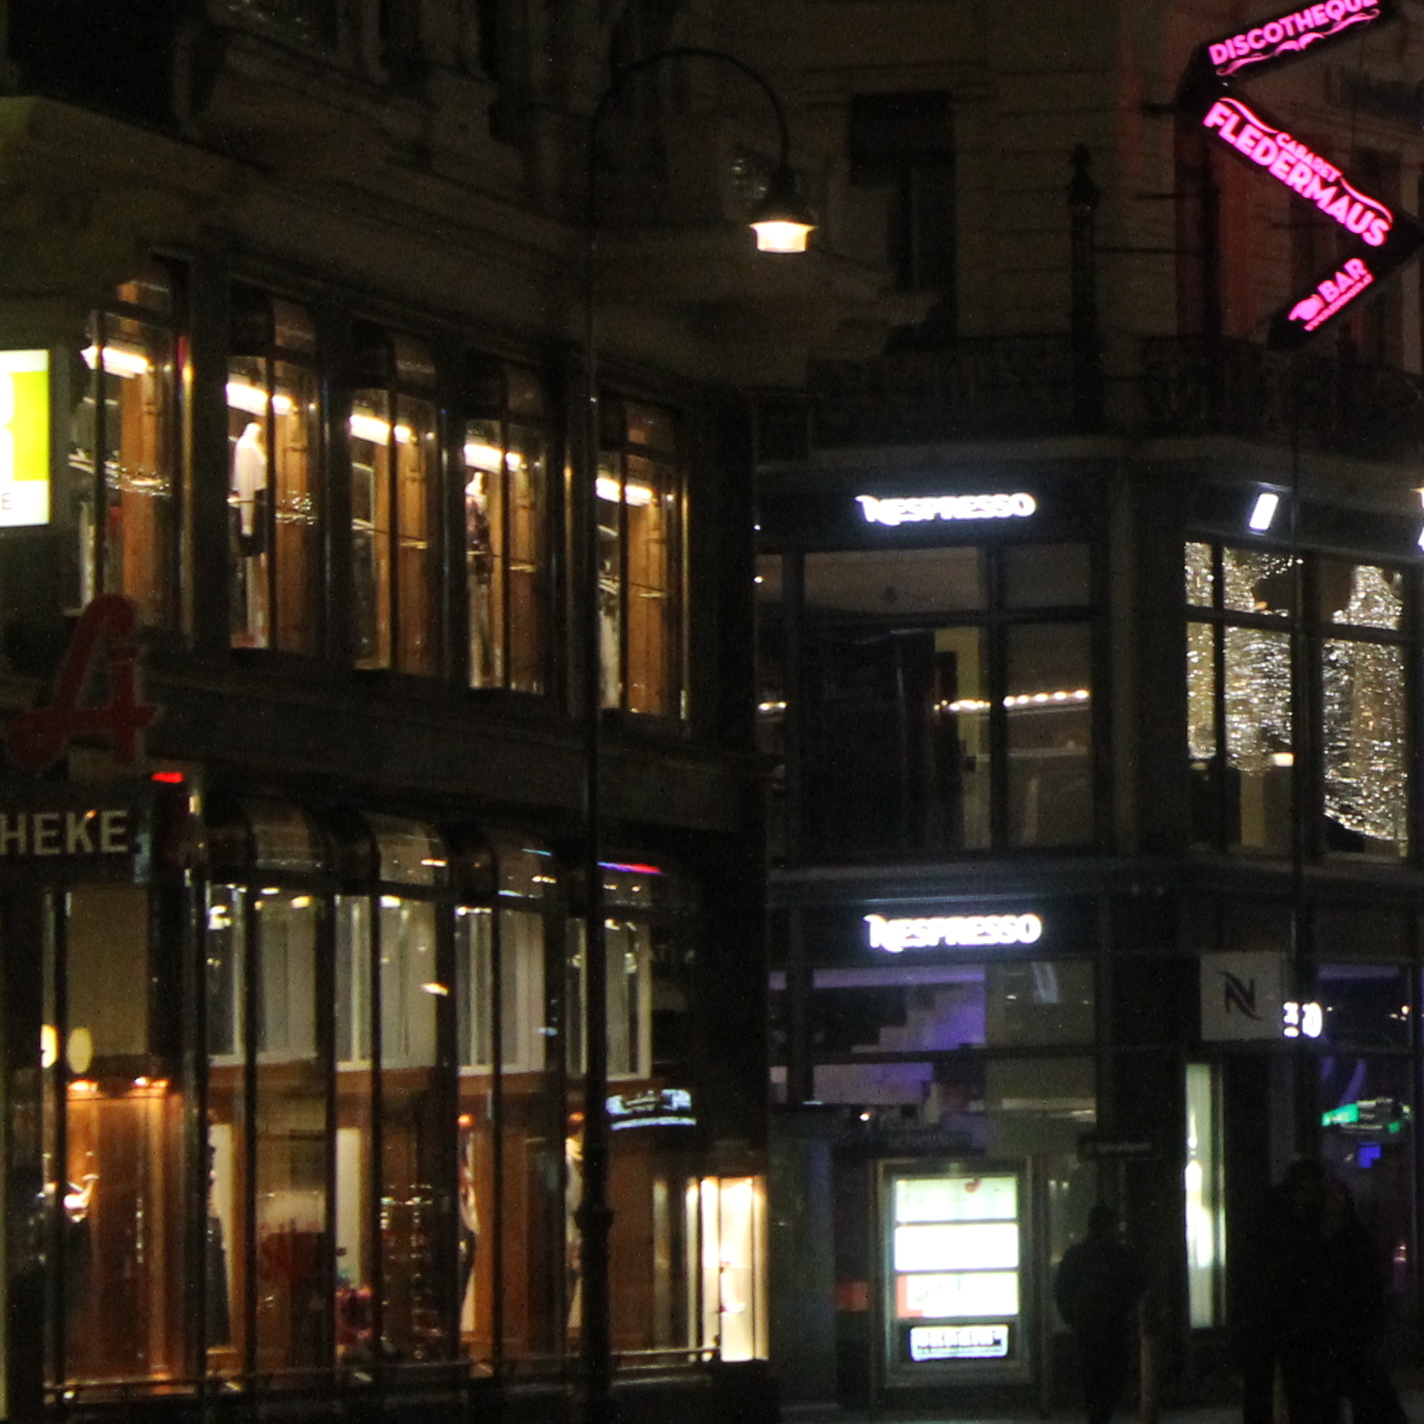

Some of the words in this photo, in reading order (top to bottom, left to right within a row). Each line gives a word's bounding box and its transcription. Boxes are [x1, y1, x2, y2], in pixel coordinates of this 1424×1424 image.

[1202, 99, 1391, 247] FLEDERMAUS
[1275, 131, 1343, 183] CABARET
[1317, 257, 1369, 303] BAR
